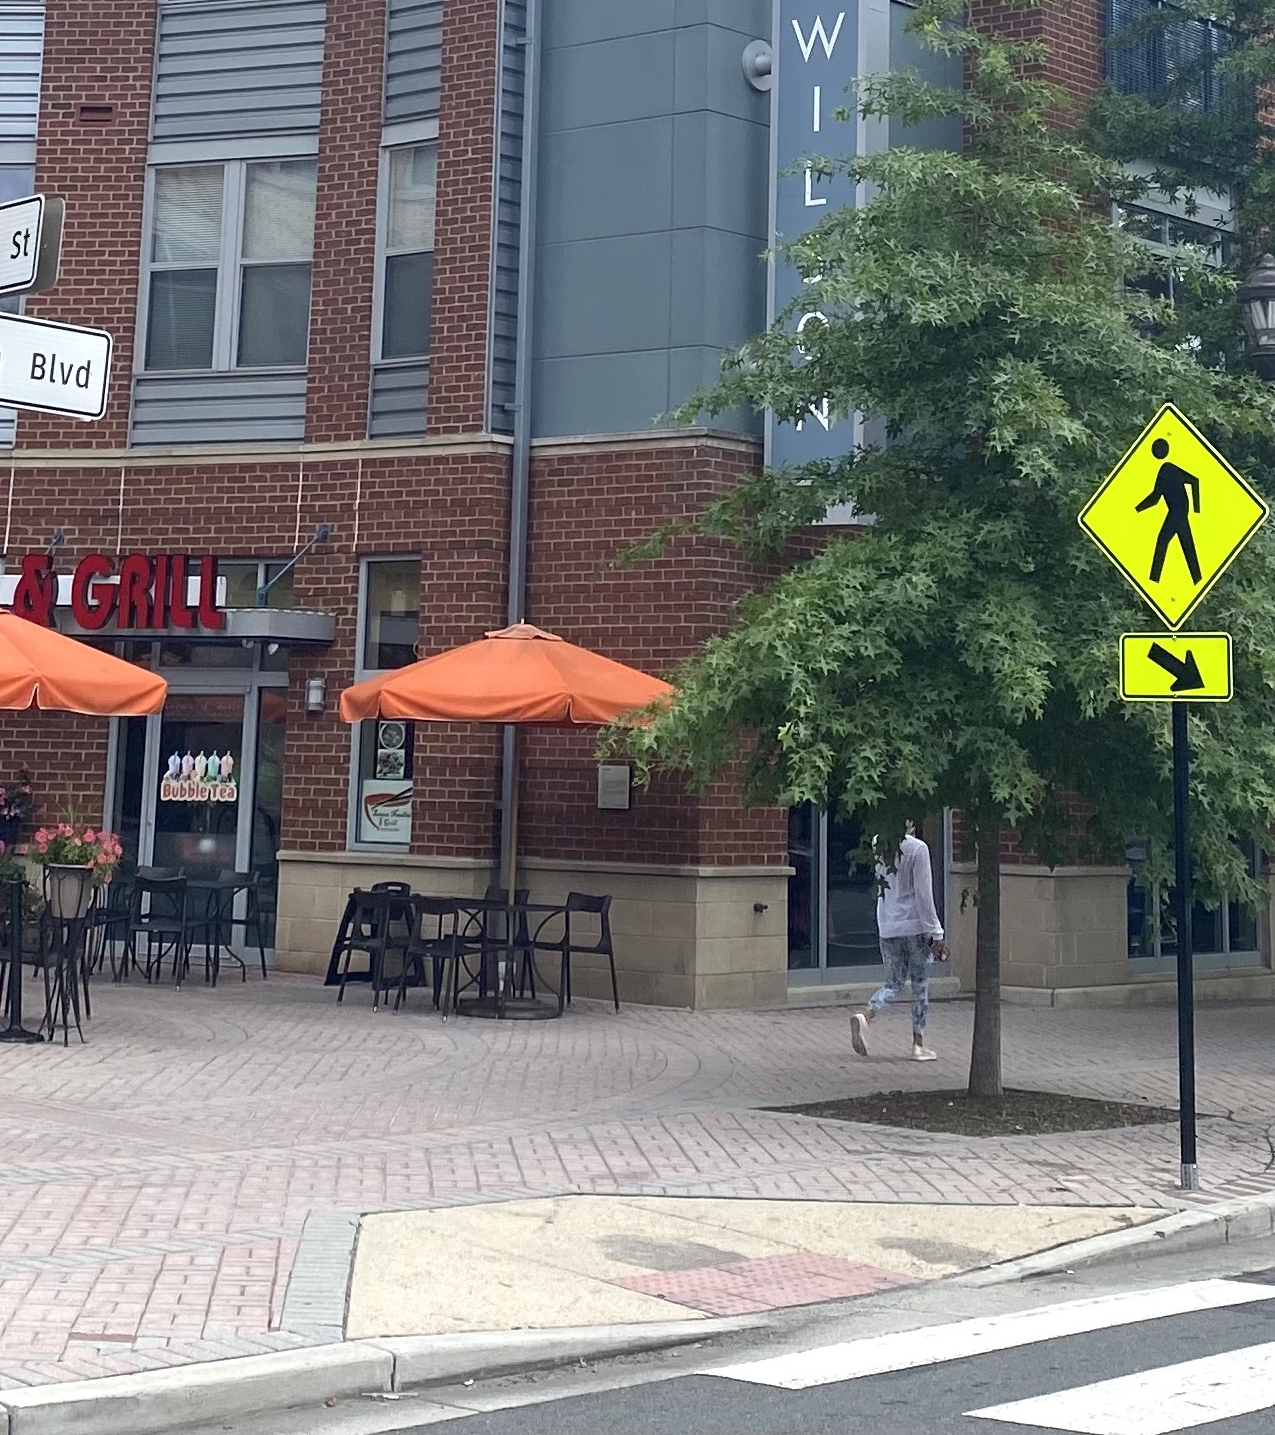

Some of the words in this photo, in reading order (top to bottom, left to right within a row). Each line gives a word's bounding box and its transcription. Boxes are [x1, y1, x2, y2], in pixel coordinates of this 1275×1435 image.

[10, 227, 31, 260] St
[29, 352, 92, 390] Blvd
[13, 554, 57, 628] &
[72, 553, 224, 630] GRILL
[163, 782, 208, 799] Bubble
[210, 783, 235, 799] Tea
